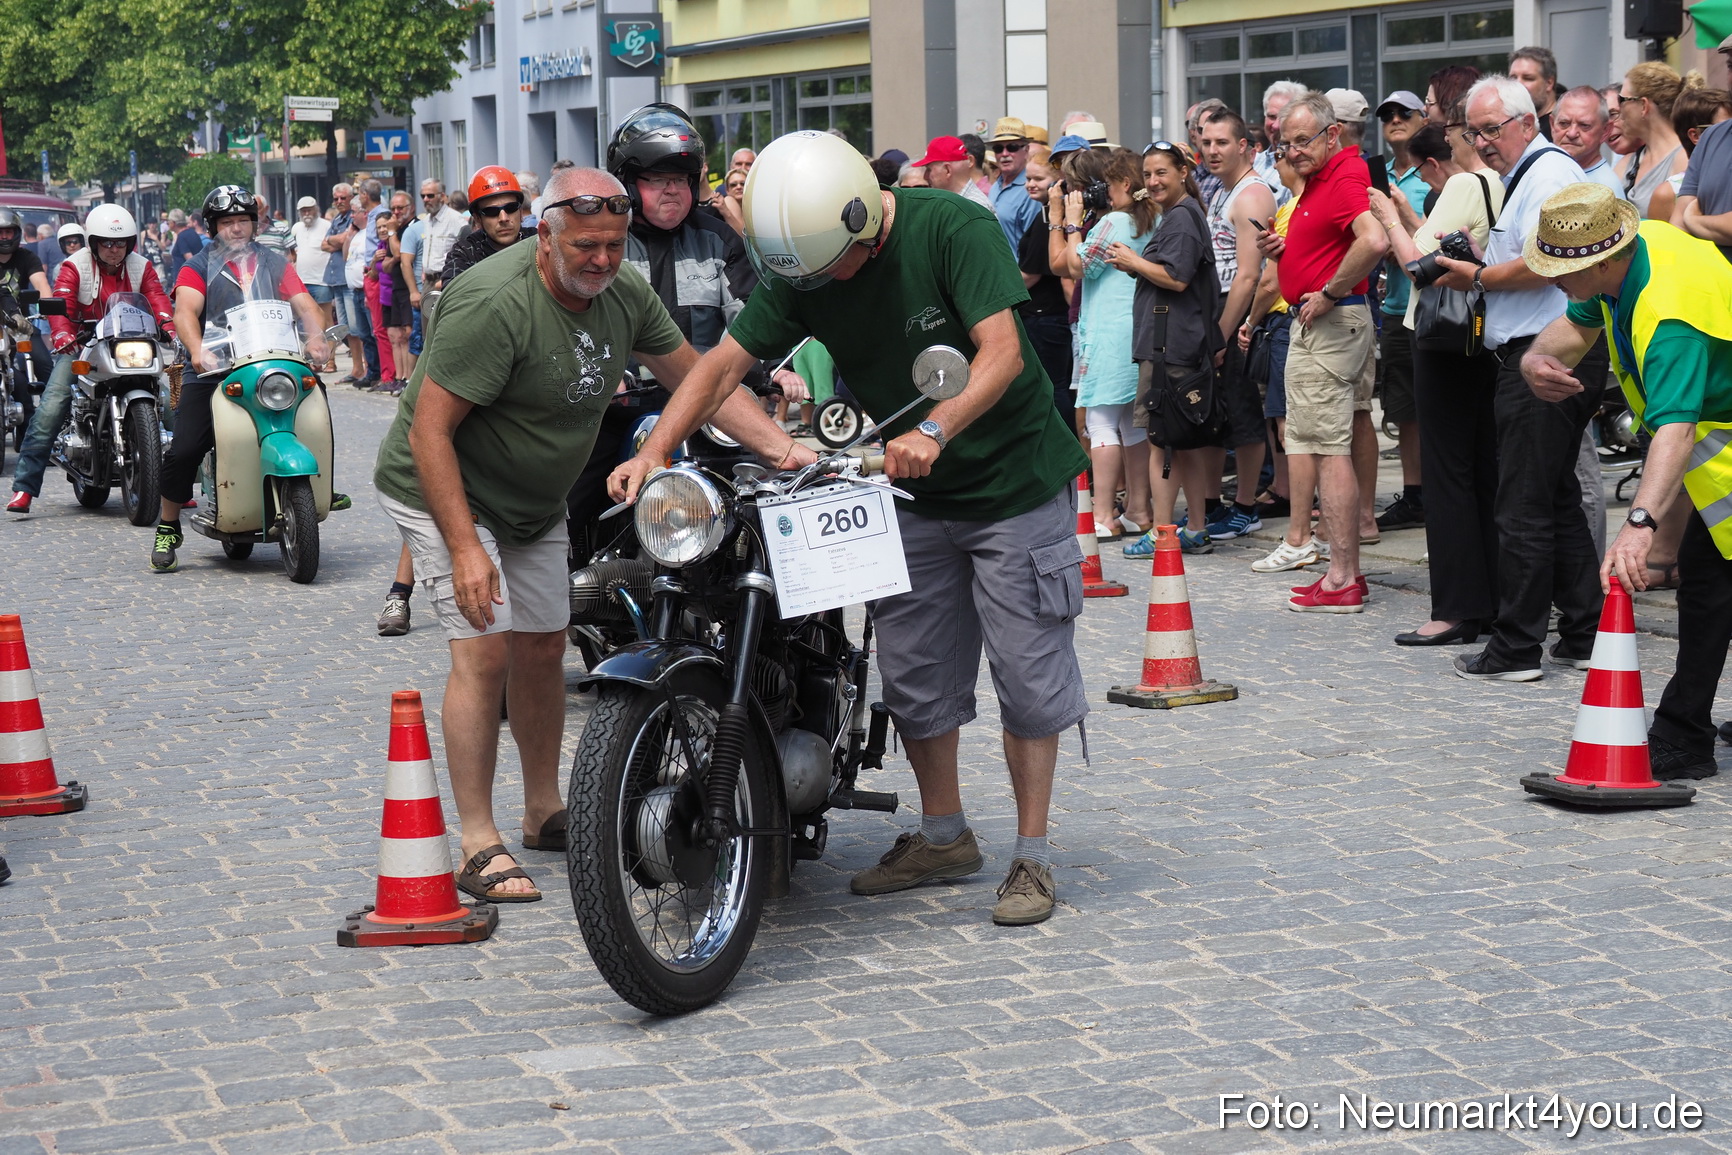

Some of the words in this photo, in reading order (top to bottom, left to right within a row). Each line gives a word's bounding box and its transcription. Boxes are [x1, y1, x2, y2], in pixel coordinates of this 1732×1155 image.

[625, 30, 646, 56] G2
[290, 99, 338, 107] Brunnwirtsgasse
[261, 310, 283, 320] 655
[817, 504, 869, 537] 260
